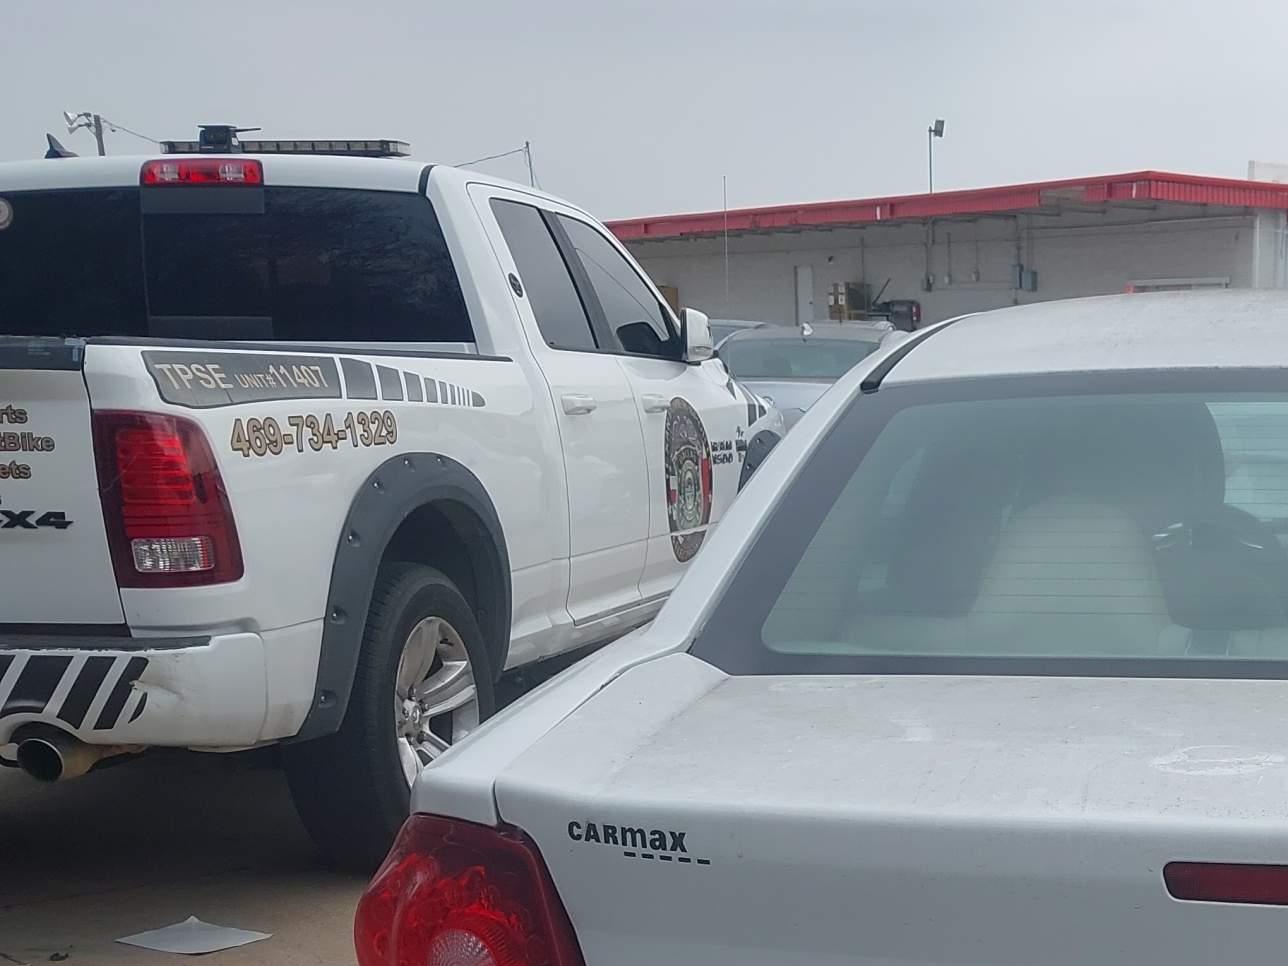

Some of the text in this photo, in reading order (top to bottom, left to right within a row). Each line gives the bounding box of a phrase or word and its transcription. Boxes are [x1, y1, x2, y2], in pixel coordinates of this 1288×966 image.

[154, 363, 329, 390] TPSE UNIT#11407
[230, 410, 398, 457] 469-734-1329
[0, 510, 74, 529] X4
